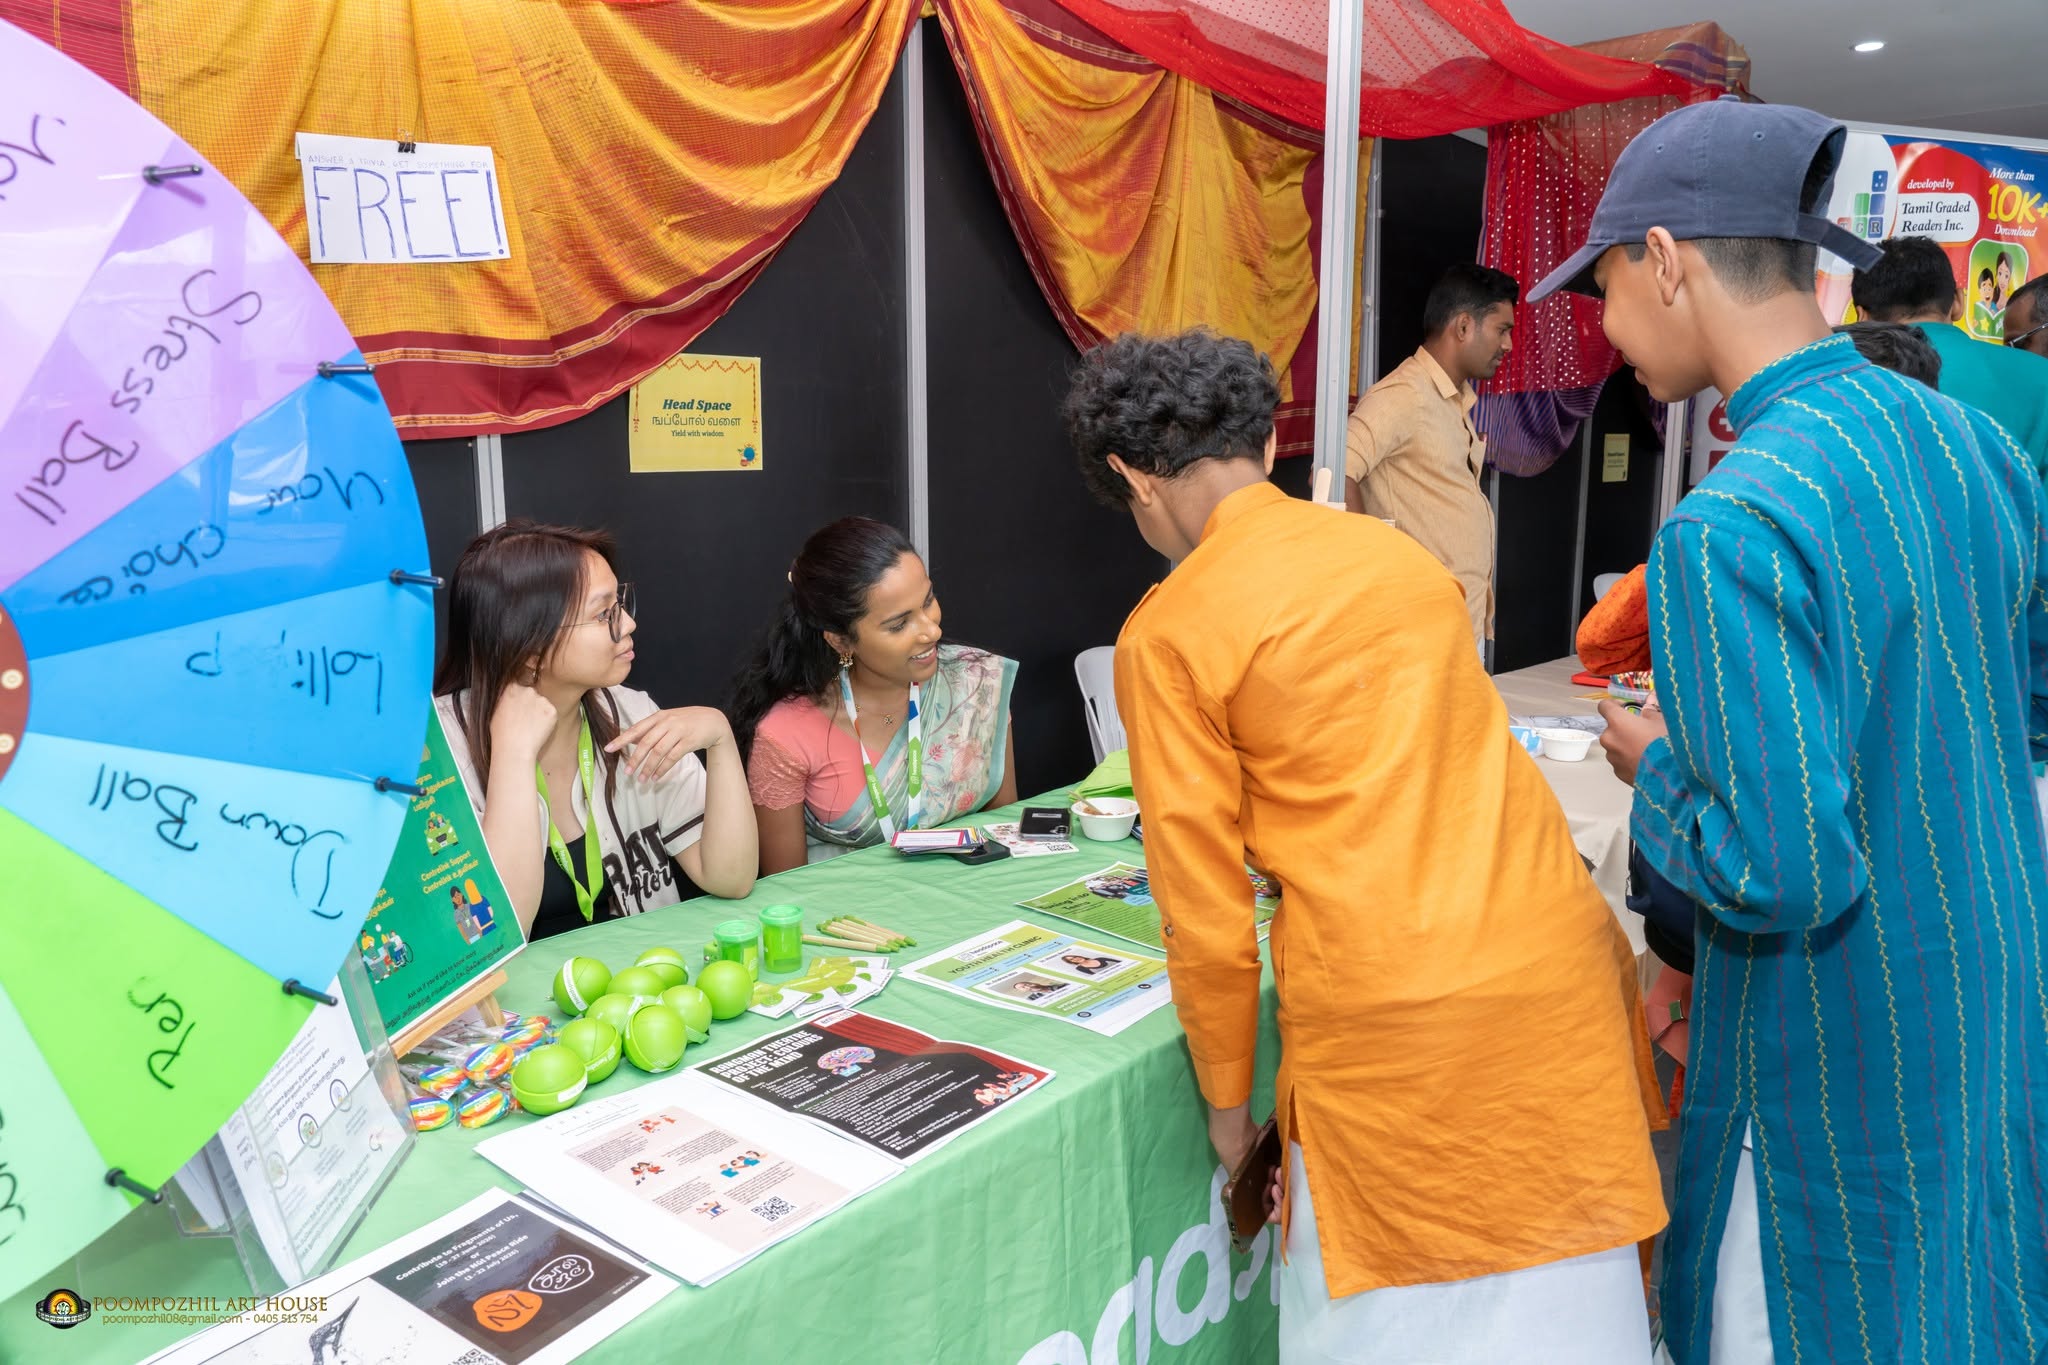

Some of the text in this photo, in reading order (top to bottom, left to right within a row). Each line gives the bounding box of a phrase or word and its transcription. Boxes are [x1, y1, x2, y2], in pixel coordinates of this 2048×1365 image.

[308, 154, 343, 164] ANSWER
[417, 160, 466, 169] SOMETHING
[1989, 167, 2035, 182] More than
[1907, 178, 1955, 190] developed by
[312, 165, 505, 260] FREE!
[1902, 200, 1971, 215] Tamil Graded
[1988, 183, 2048, 225] 10K+
[1901, 219, 1964, 233] Readers Inc.
[1994, 223, 2038, 238] Download
[110, 268, 263, 414] Stress
[662, 398, 732, 413] Head Space
[707, 416, 741, 427] வளை
[14, 419, 140, 527] Ball
[89, 763, 199, 852] Ball
[421, 849, 471, 882] Centrelink Support
[948, 935, 1042, 975] YOUTH HEALTH CLINIC
[707, 1030, 815, 1073] RANGMAN THEATRE
[718, 1034, 825, 1078] PROJECT: COLOURS
[729, 1051, 806, 1083] OF THE MIND
[394, 1253, 443, 1281] Contribute
[441, 1248, 453, 1256] to
[450, 1225, 496, 1251] Fragments
[502, 1213, 519, 1222] Us,
[434, 1274, 456, 1288] Join
[453, 1266, 471, 1277] the
[484, 1245, 511, 1260] Peace
[508, 1234, 529, 1247] Ride
[468, 1251, 481, 1259] or
[484, 1259, 501, 1269] July
